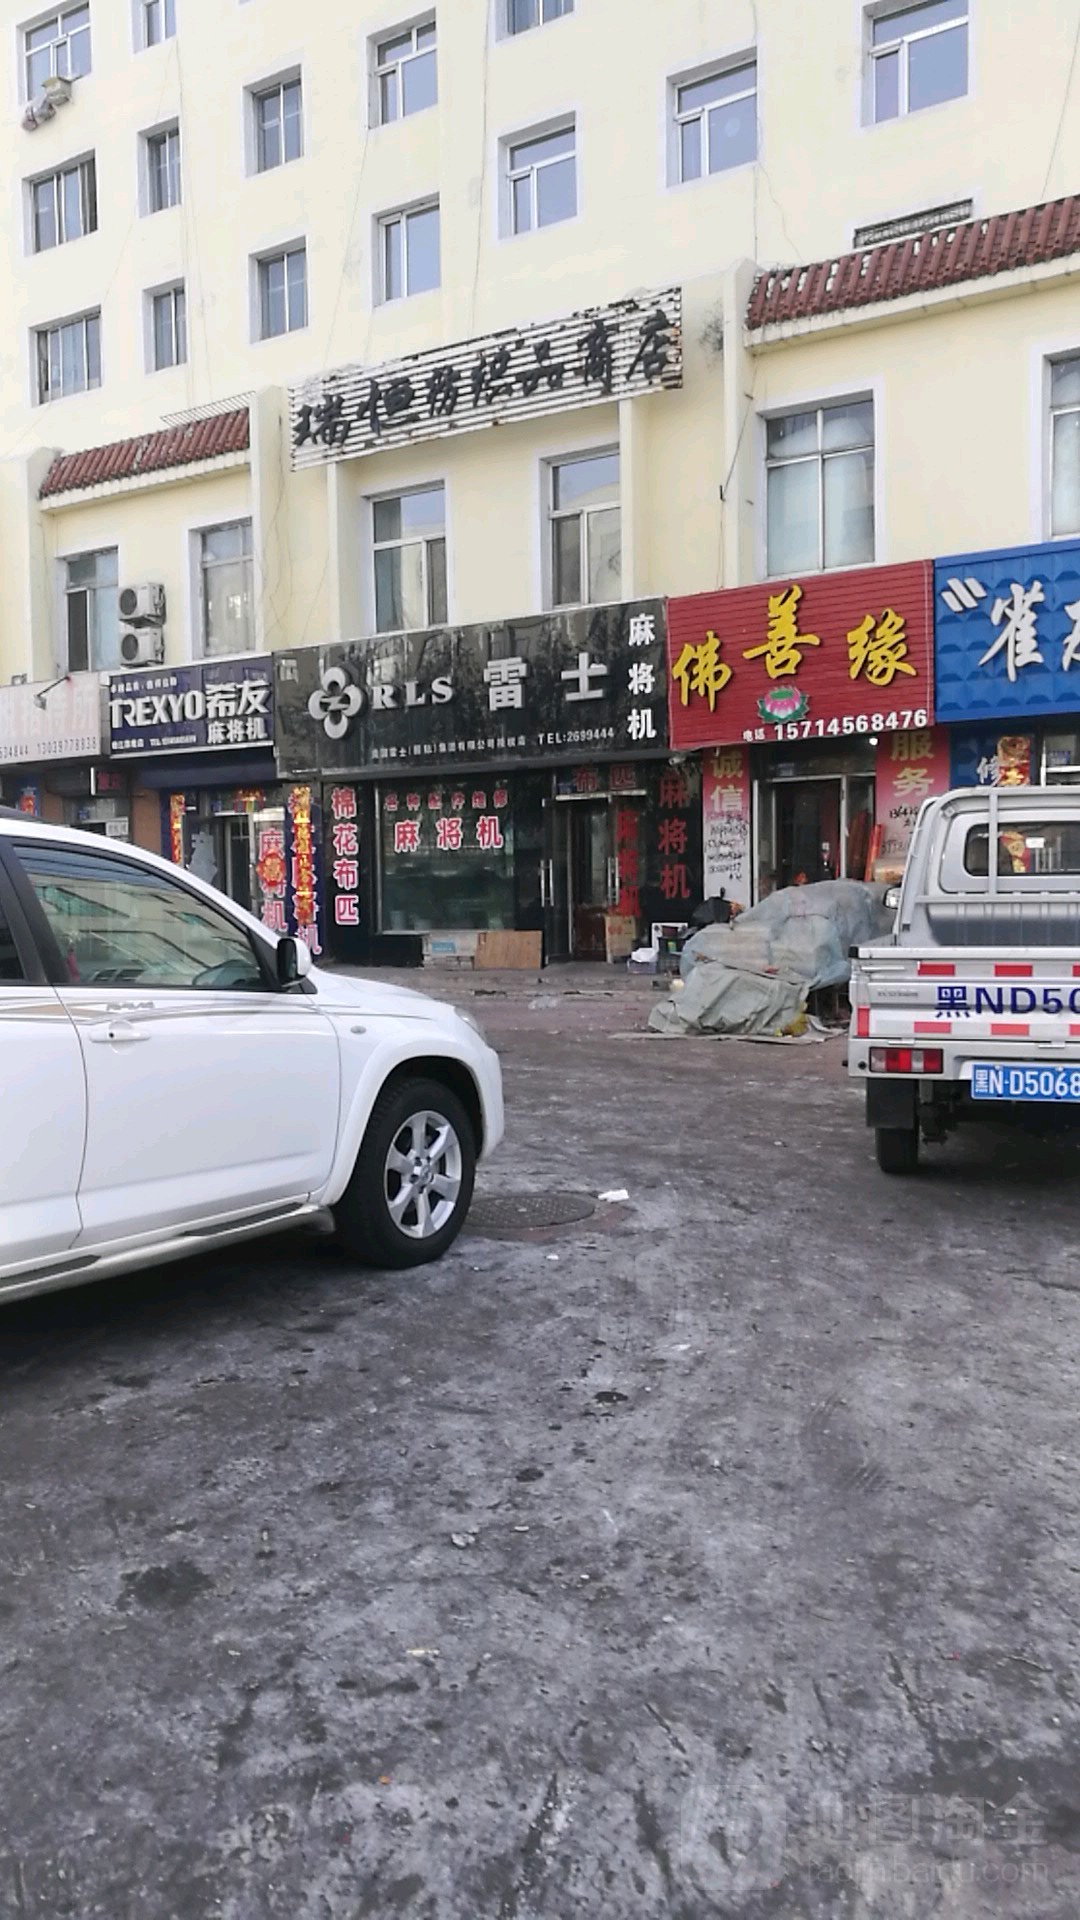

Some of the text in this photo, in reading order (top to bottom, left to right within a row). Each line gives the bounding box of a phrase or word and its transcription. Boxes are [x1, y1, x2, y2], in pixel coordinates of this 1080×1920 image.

[627, 612, 658, 741] 麻将机
[671, 584, 917, 712] 佛善缘
[109, 690, 205, 728] TREXYO
[205, 680, 270, 718] 希友
[371, 652, 608, 711] RLS 雷士
[207, 717, 268, 743] 麻将机
[743, 708, 928, 742] 电话 15714568476
[573, 764, 637, 792] 布匹
[709, 749, 744, 812] 诚信
[889, 731, 936, 797] 服务
[331, 787, 359, 927] 棉花布匹
[394, 815, 504, 853] 麻将机
[615, 810, 641, 918] 麻将机
[658, 769, 691, 900] 麻将机
